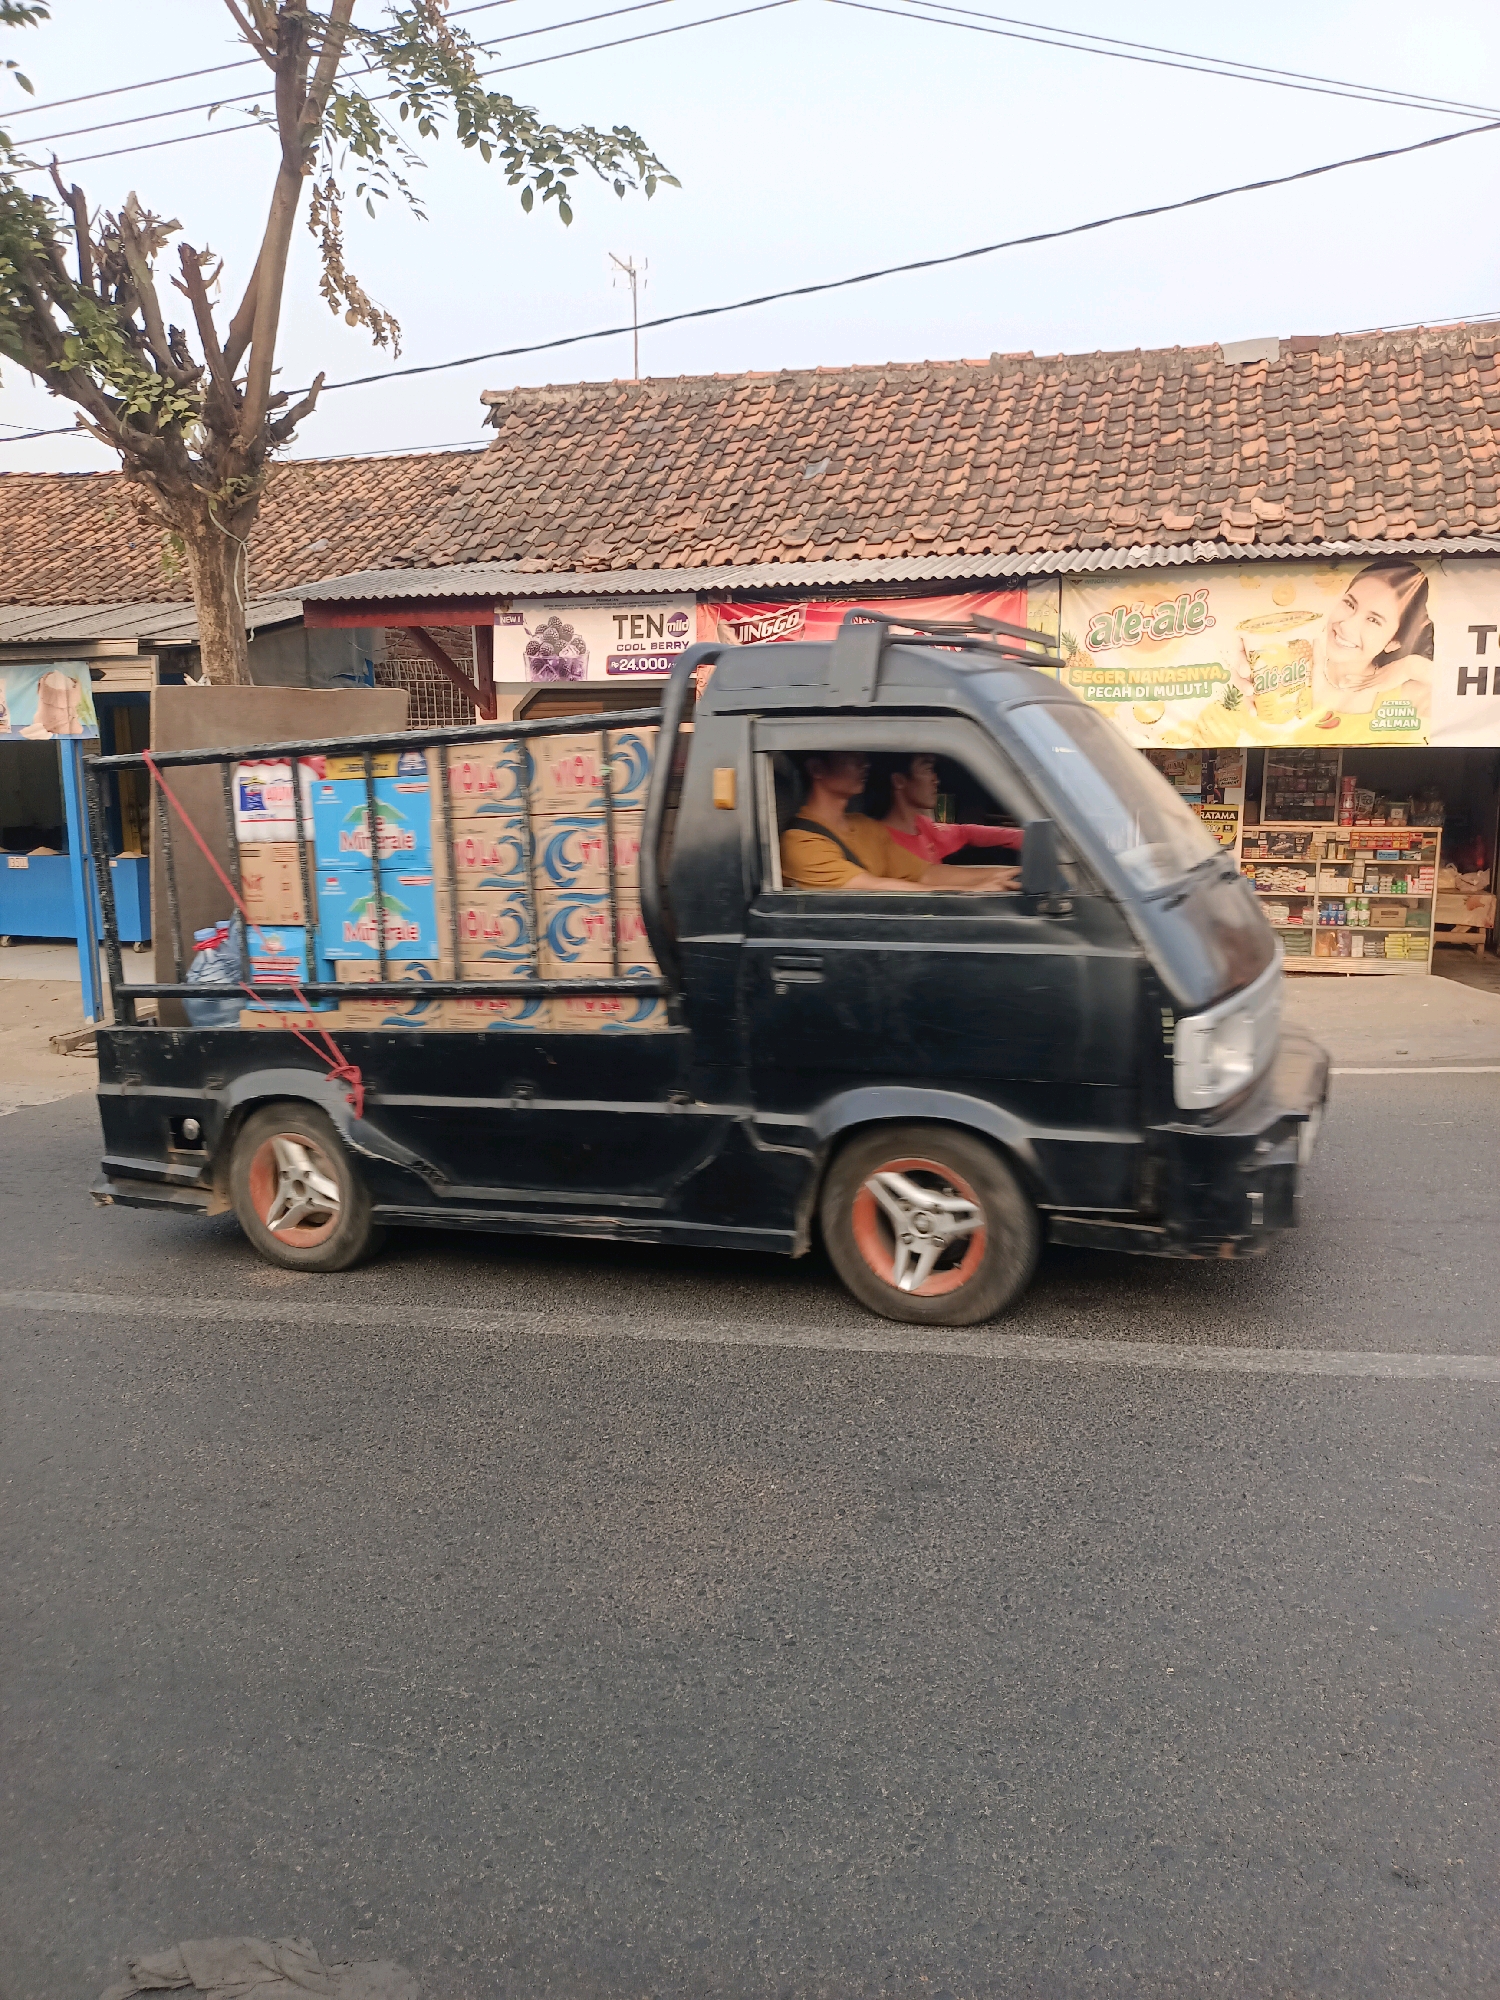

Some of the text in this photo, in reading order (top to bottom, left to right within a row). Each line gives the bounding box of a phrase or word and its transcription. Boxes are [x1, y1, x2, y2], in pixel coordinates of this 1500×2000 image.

[612, 613, 664, 640] TEN
[1467, 625, 1500, 655] T
[617, 641, 690, 652] COOL BERRY
[1071, 665, 1228, 685] SEGER NANASNYA,
[1087, 686, 1132, 698] PECAH
[1135, 686, 1150, 698] DI
[1377, 707, 1415, 719] QUINN
[1371, 719, 1419, 728] SALMAN
